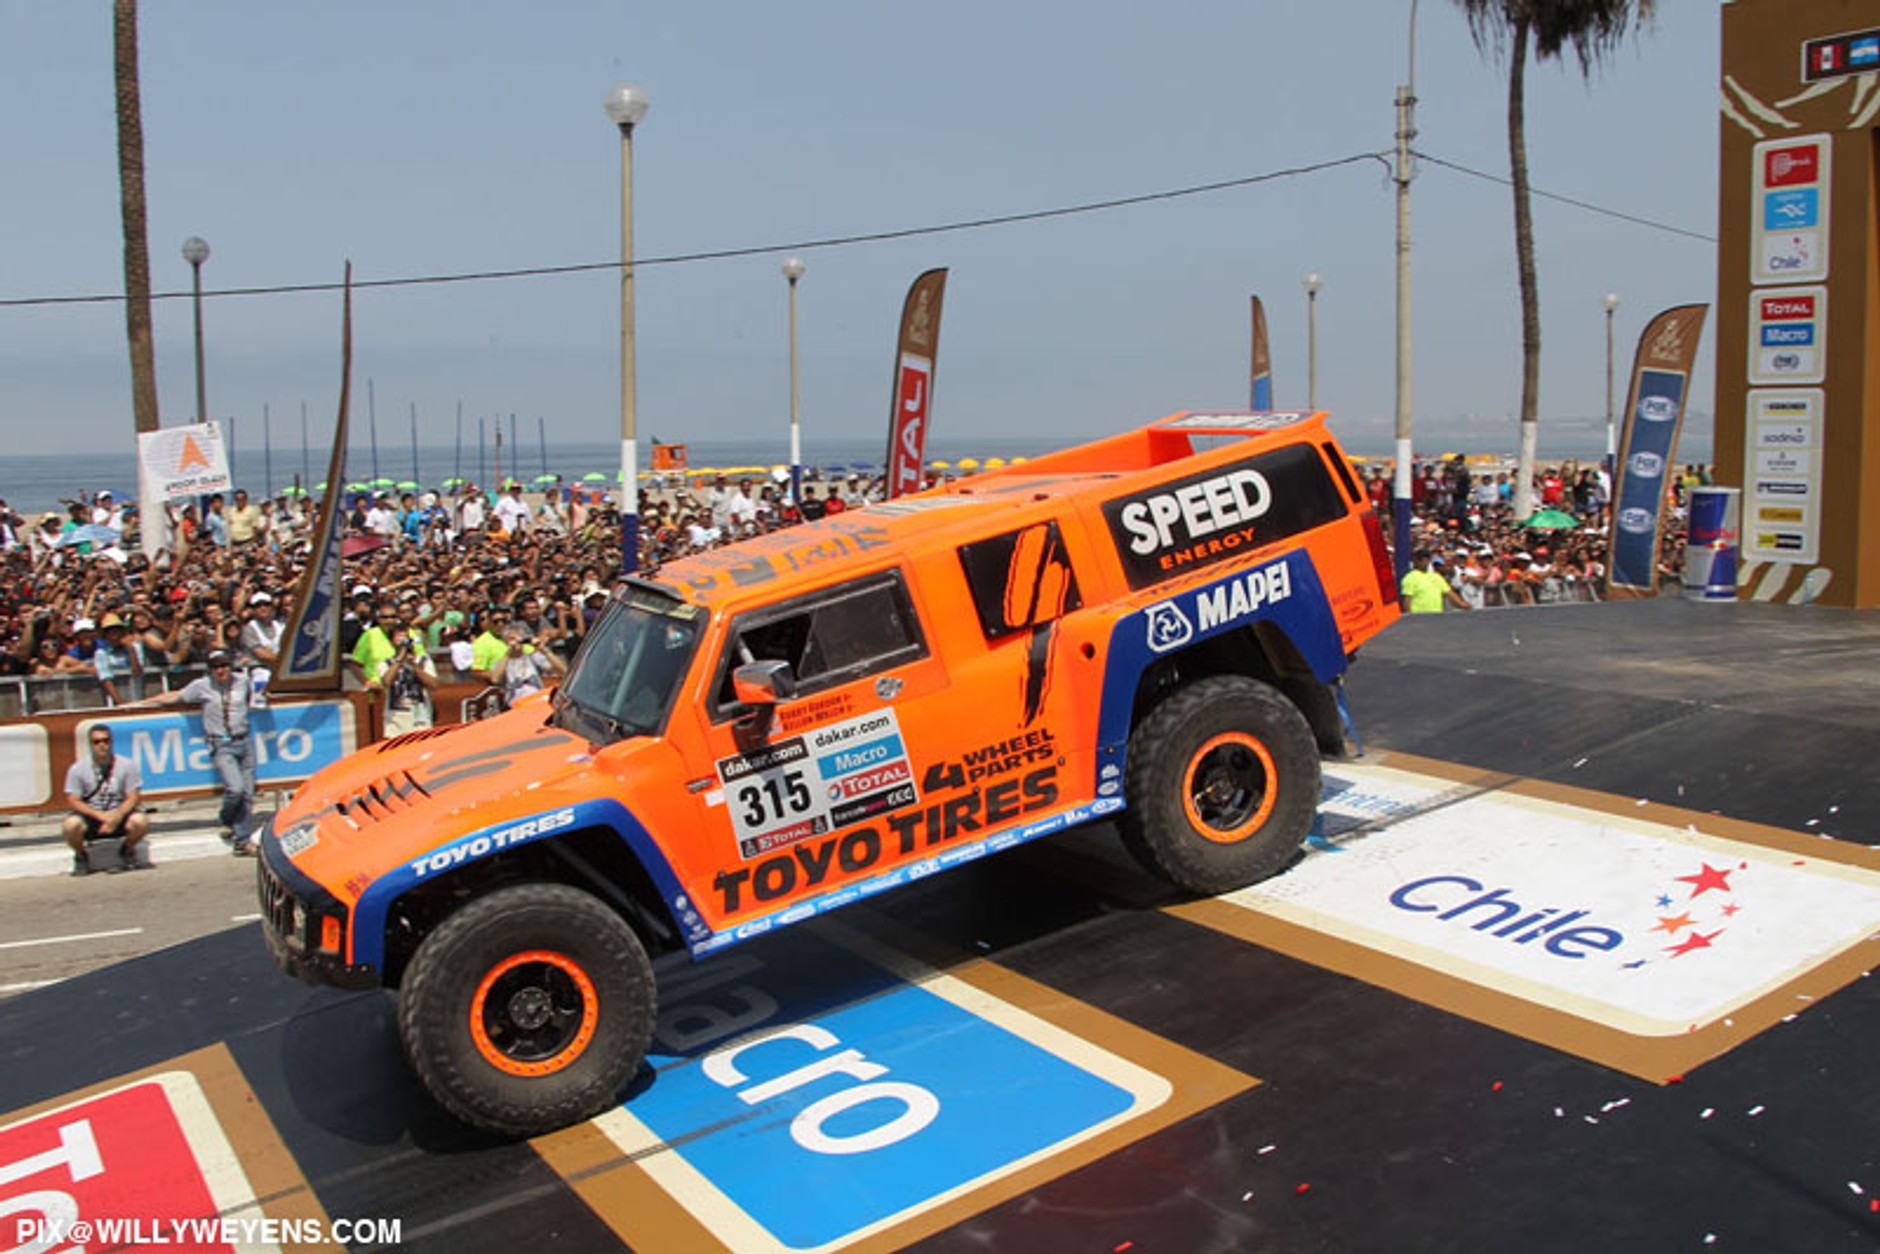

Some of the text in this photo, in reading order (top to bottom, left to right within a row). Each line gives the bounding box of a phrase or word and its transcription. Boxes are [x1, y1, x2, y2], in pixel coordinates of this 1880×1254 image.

[1769, 256, 1801, 270] Chile
[1766, 302, 1810, 315] TOTAL
[1766, 328, 1808, 342] Macro
[899, 379, 922, 490] TAL
[1121, 469, 1271, 555] SPEED
[1159, 527, 1255, 571] ENERGY
[1197, 561, 1291, 632] MAPEI
[131, 726, 313, 775] Maro
[816, 716, 890, 748] dakar.com
[963, 729, 1054, 766] WHEEL
[725, 744, 803, 777] dakar.com
[834, 745, 887, 771] Macro
[845, 762, 908, 793] TOTAL
[923, 744, 1053, 793] 4 PARTS
[738, 771, 811, 827] 315
[411, 808, 576, 876] TOYO TIRES
[714, 765, 1059, 914] TOYO TIRES
[772, 826, 810, 845] TOTAL
[1389, 874, 1624, 960] Chile
